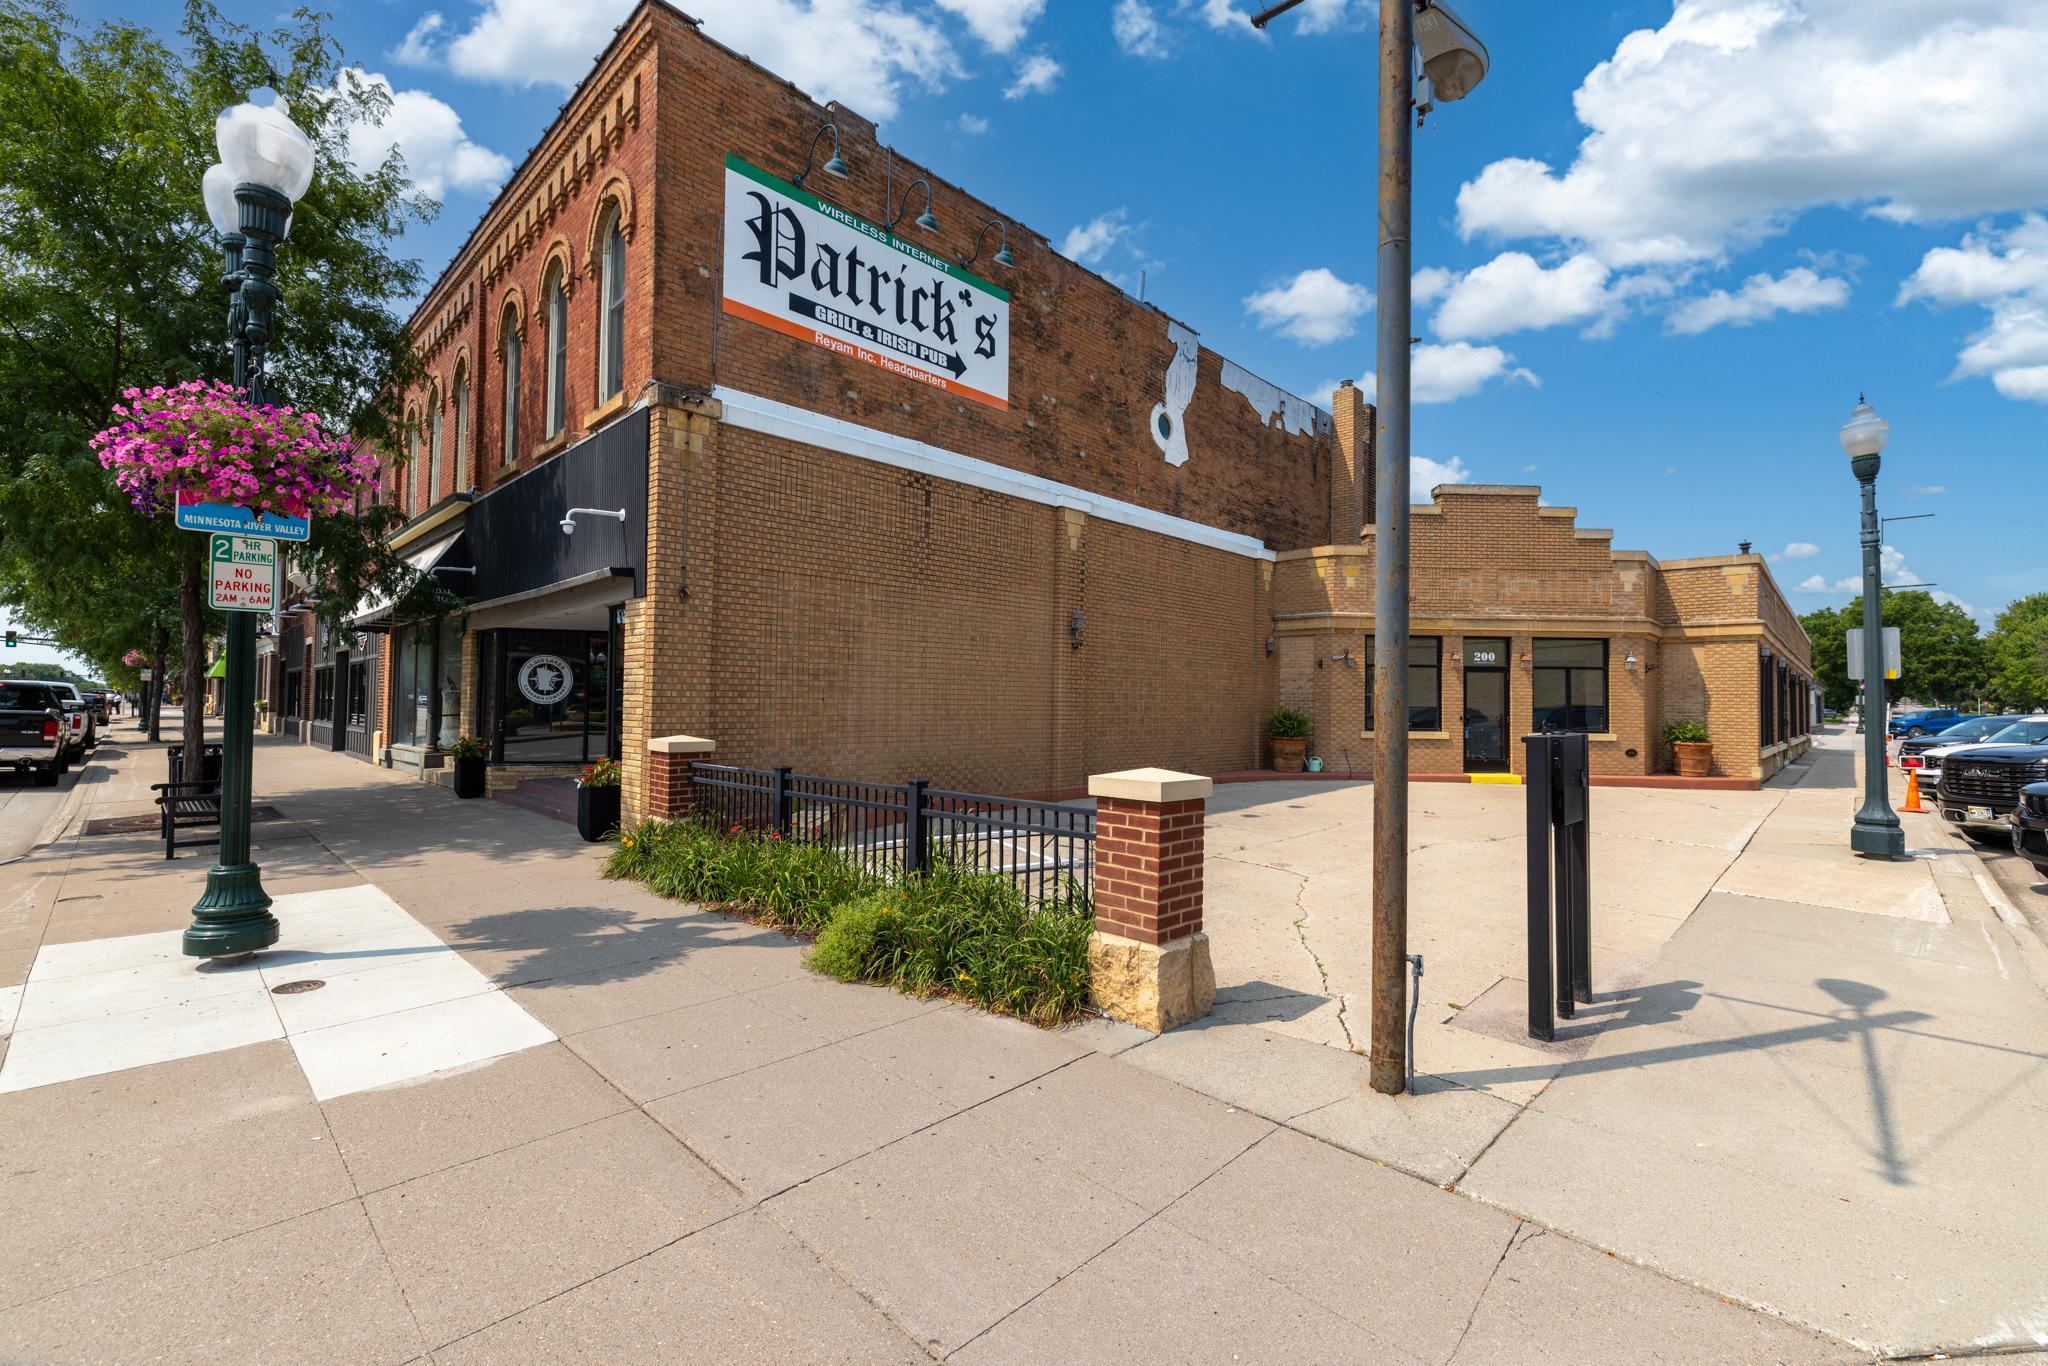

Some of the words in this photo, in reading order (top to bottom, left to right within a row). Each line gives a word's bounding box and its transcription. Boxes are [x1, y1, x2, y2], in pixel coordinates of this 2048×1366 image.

[817, 201, 887, 243] WIRELESS
[892, 238, 950, 272] INTERNET
[814, 305, 860, 335] GRILL
[862, 324, 874, 341] &
[876, 331, 917, 357] IRISH
[920, 346, 949, 368] PUB
[815, 331, 854, 357] Reyam
[857, 348, 877, 364] Inc.
[880, 355, 948, 389] Headquarters
[184, 514, 241, 529] MINNESOTA
[244, 521, 272, 532] RIVER
[275, 524, 305, 536] VALLEY
[215, 539, 230, 559] 2
[245, 541, 260, 551] HR
[233, 551, 273, 564] PARKING
[235, 568, 253, 578] NO
[215, 580, 271, 593] PARKING
[215, 593, 237, 603] 2AM
[249, 596, 270, 604] 6AM
[1474, 652, 1495, 661] 200
[546, 658, 566, 670] LAKES
